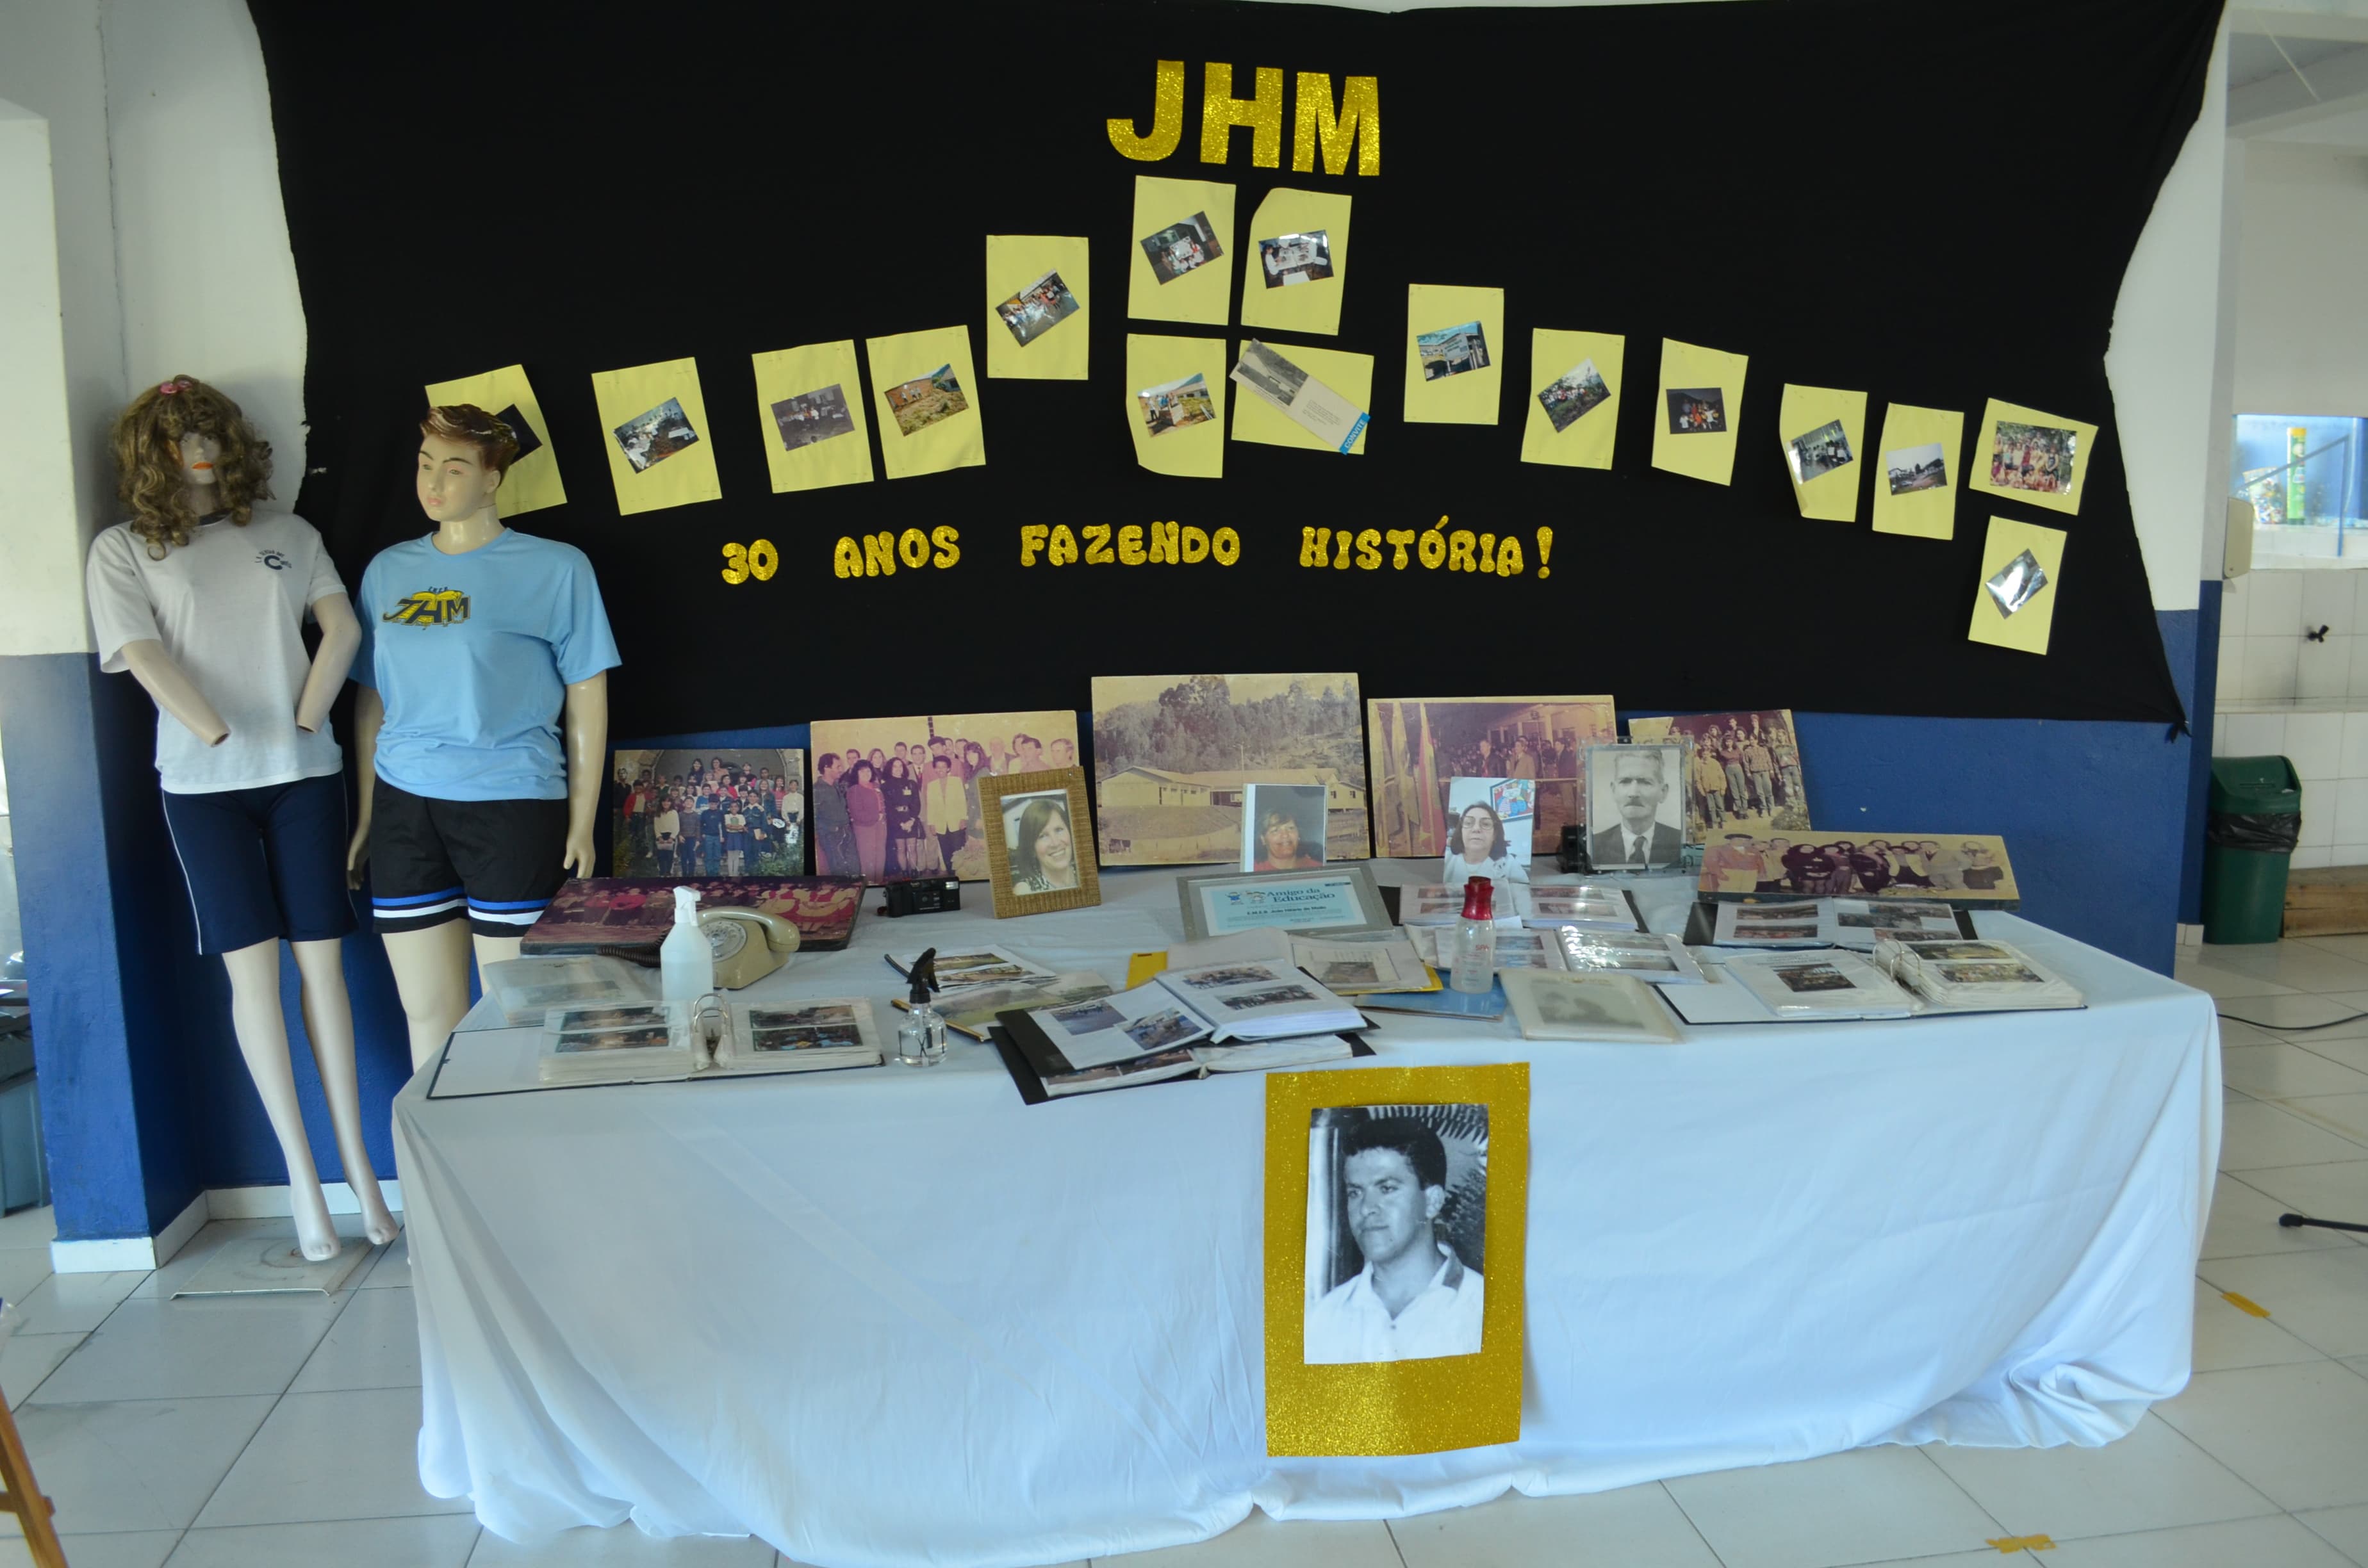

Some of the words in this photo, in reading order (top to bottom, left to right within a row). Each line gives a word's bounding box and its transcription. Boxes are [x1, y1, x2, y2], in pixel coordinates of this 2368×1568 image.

[1106, 60, 1380, 176] JHM
[1344, 418, 1365, 448] CONVITE
[721, 539, 778, 585] 30
[834, 525, 960, 578] ANOS
[1021, 521, 1240, 566] FAZENDO
[1299, 514, 1554, 578] HISTÓRIA!
[382, 596, 470, 625] JHM
[1273, 892, 1335, 902] Educação
